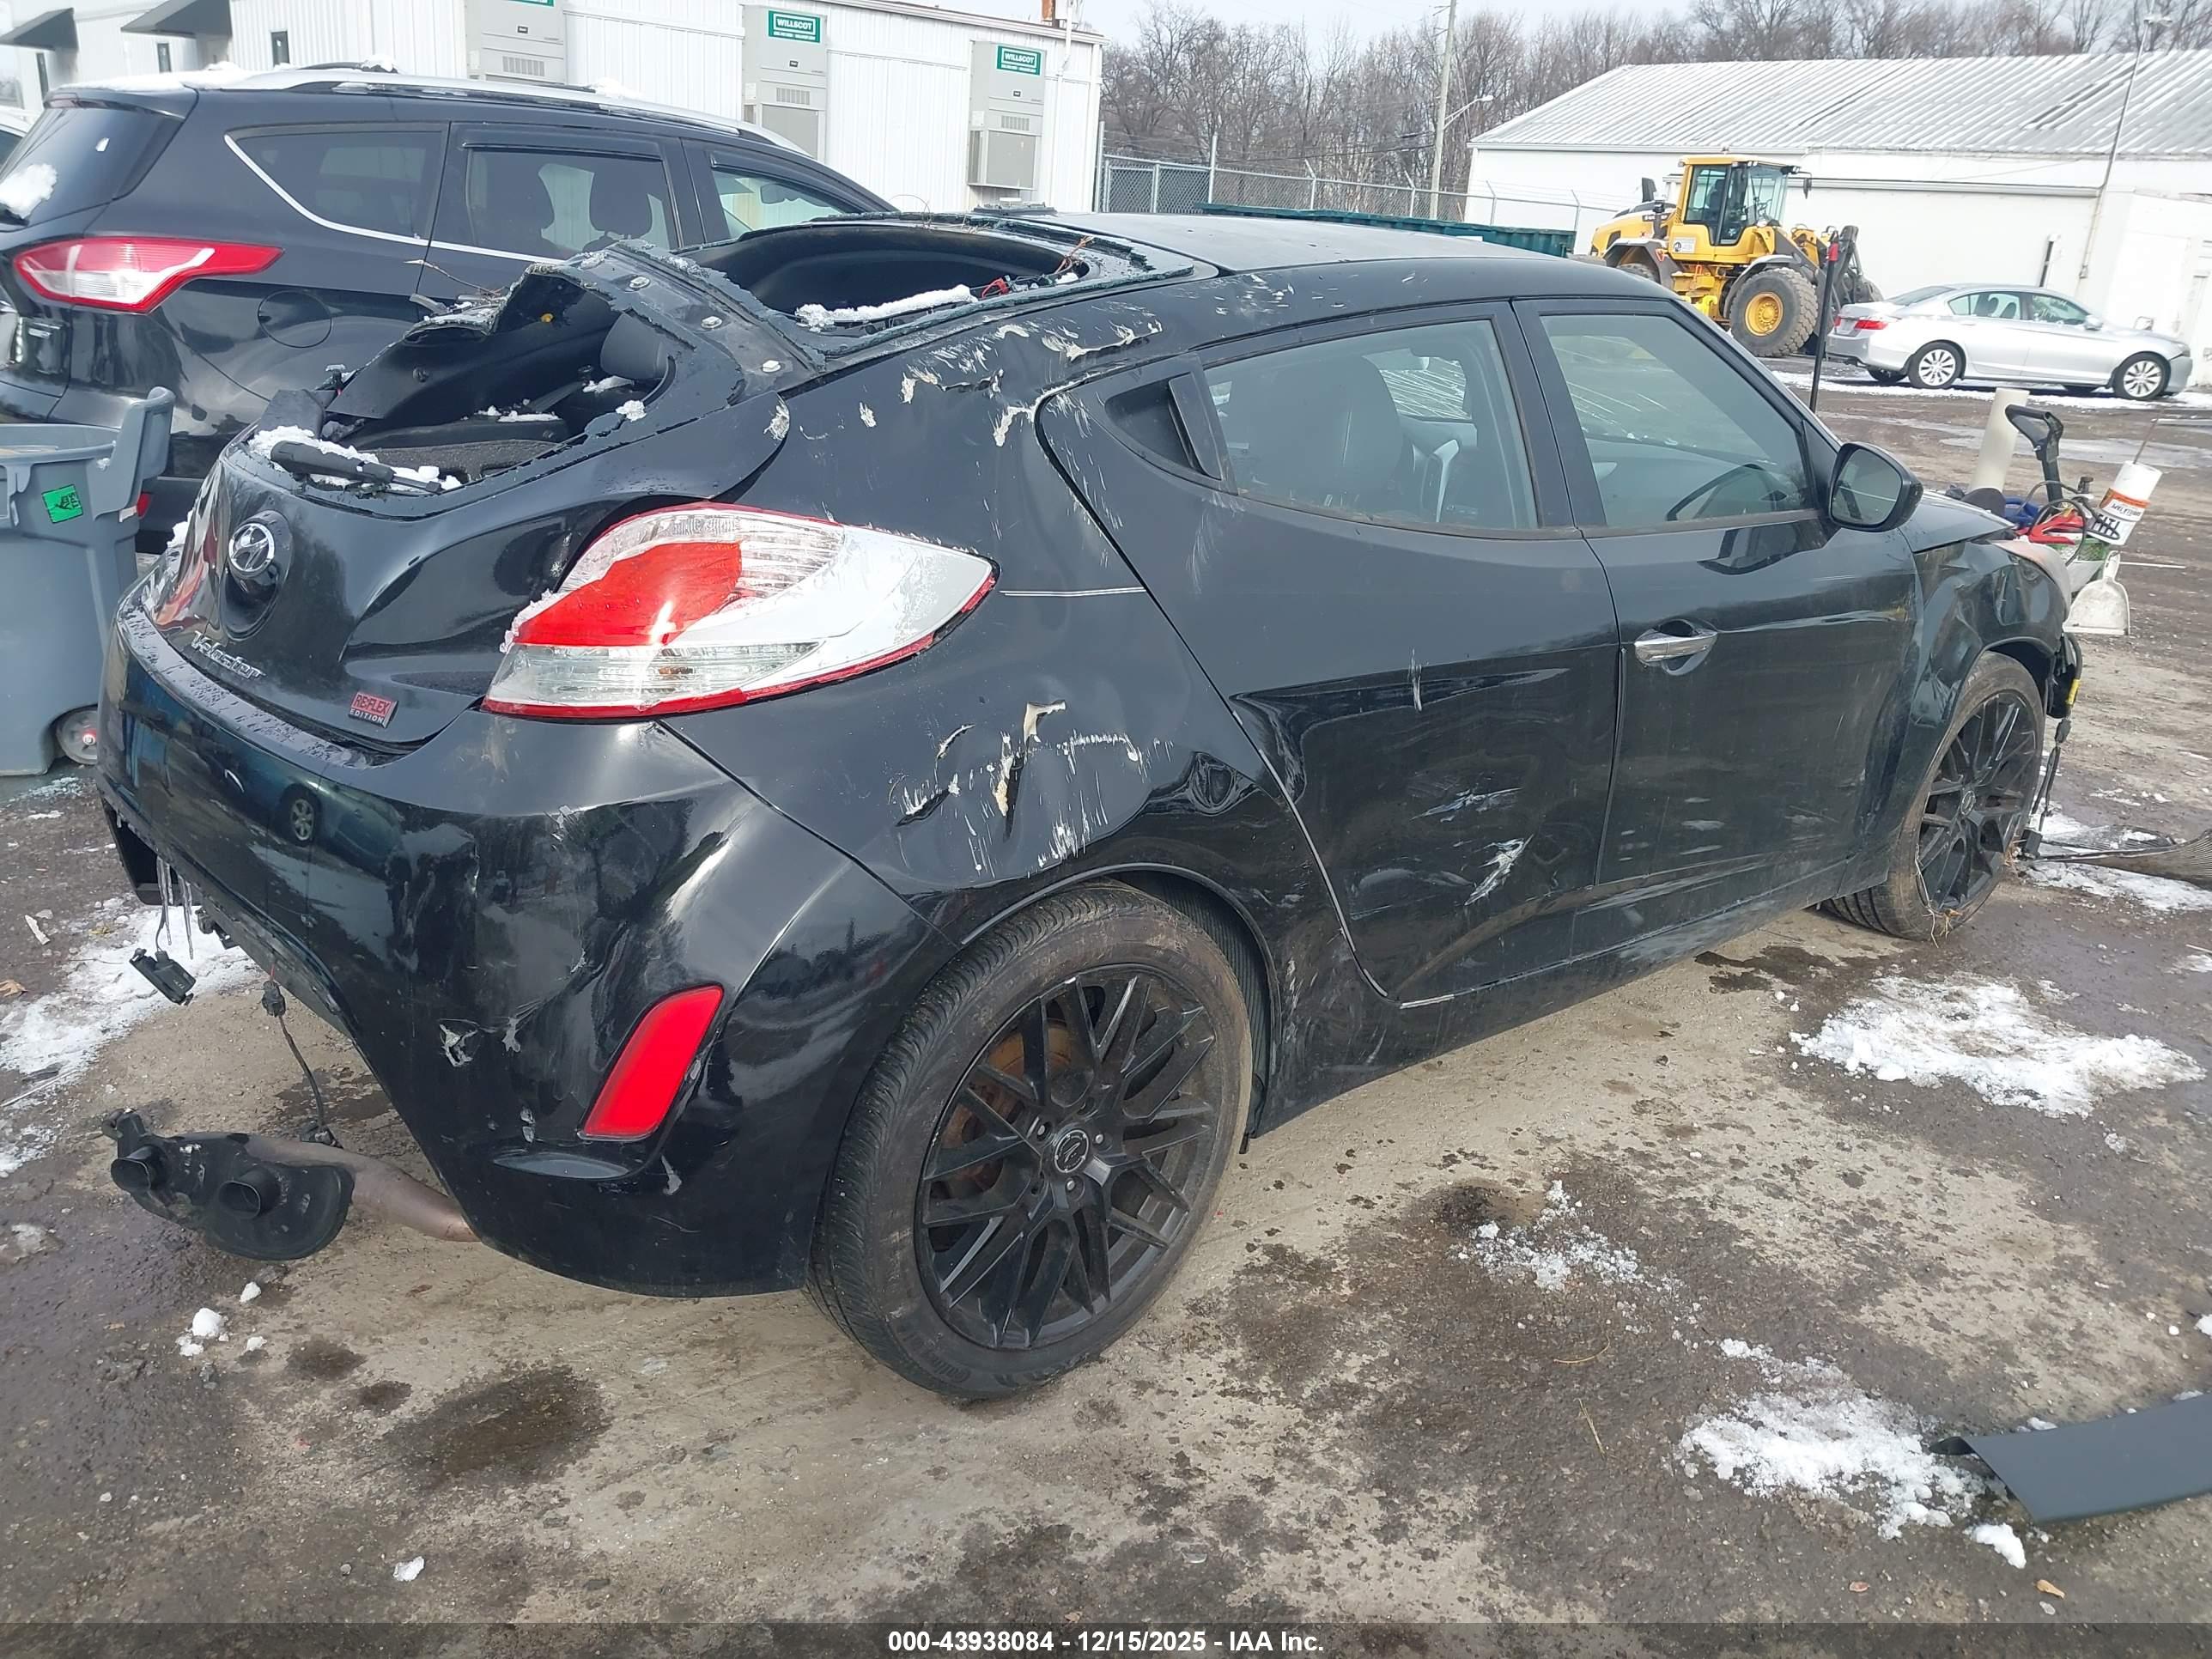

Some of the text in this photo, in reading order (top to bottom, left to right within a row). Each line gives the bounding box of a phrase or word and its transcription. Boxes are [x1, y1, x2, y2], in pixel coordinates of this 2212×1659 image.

[776, 18, 812, 30] WILLSCOT
[1005, 52, 1035, 64] WILLSCOT
[191, 630, 267, 679] Veloster
[349, 708, 385, 724] EDITION
